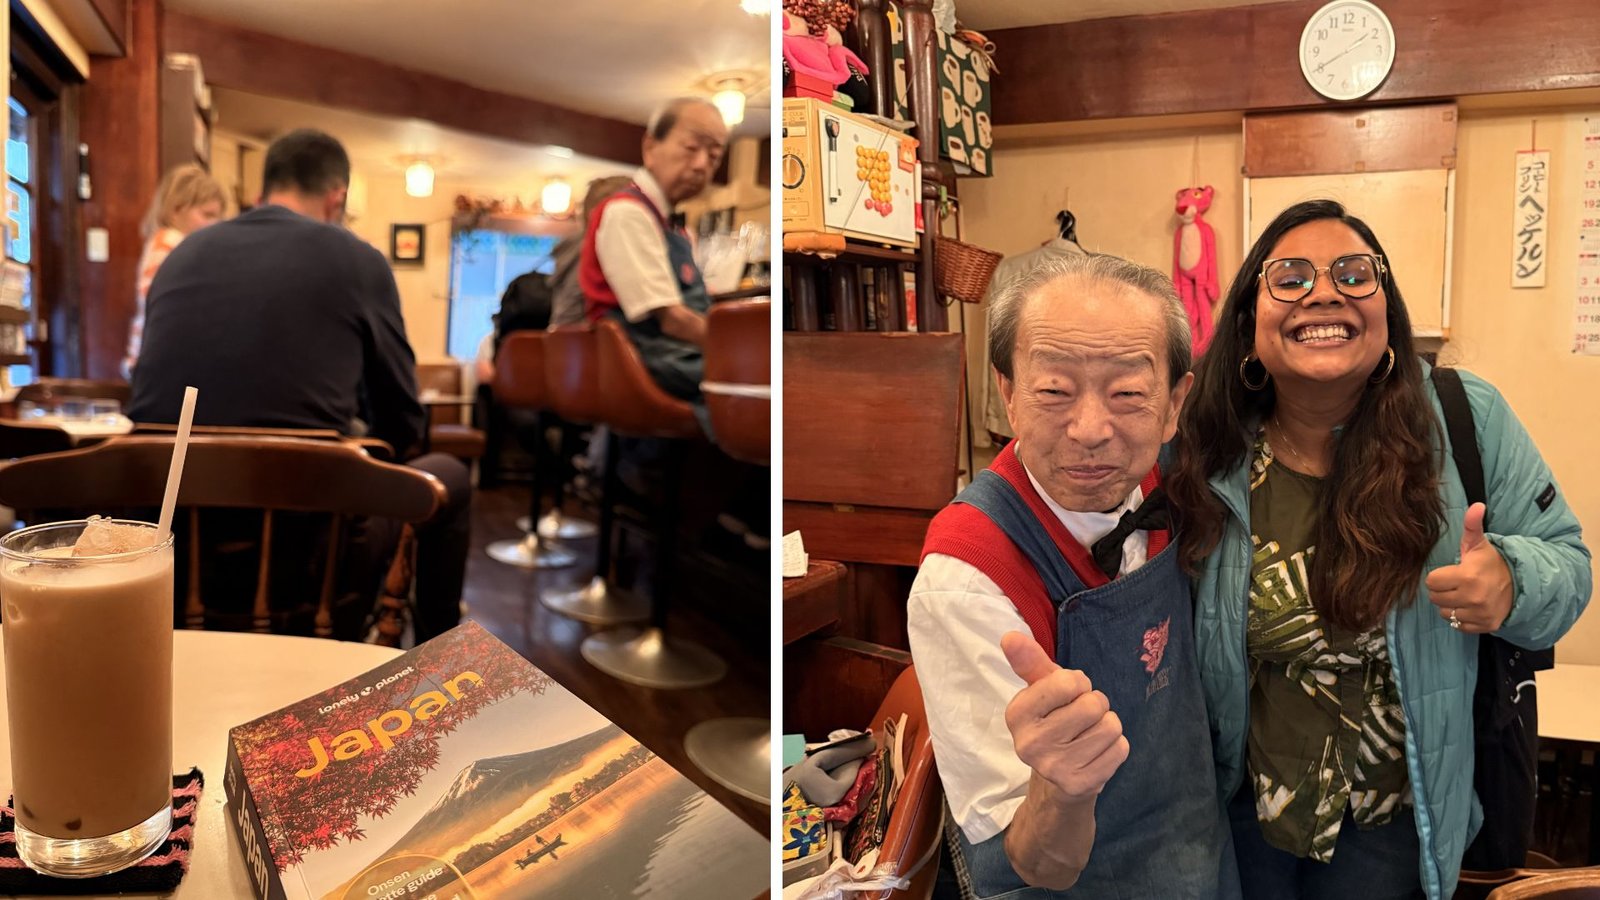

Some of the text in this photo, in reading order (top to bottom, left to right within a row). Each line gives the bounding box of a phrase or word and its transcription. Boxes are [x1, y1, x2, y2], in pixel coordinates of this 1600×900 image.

[1329, 17, 1338, 28] 11
[1343, 12, 1355, 24] 12
[1362, 16, 1367, 28] 1
[1317, 29, 1328, 40] 10
[1371, 28, 1379, 39] 2
[1312, 46, 1320, 57] 9
[1376, 45, 1383, 56] 3
[1317, 63, 1325, 73] 8
[1327, 74, 1335, 85] 7
[1587, 160, 1595, 169] 5
[1585, 180, 1596, 189] 12
[1585, 200, 1596, 208] 19
[1582, 219, 1594, 228] 26
[1581, 277, 1588, 286] 3
[1579, 296, 1590, 304] 10
[1578, 315, 1588, 323] 17
[1588, 334, 1600, 342] 25
[318, 666, 415, 715] lonely planet
[294, 671, 485, 779] Japan
[238, 790, 269, 900] Japan
[367, 870, 411, 896] Onsen
[407, 867, 443, 892] guide
